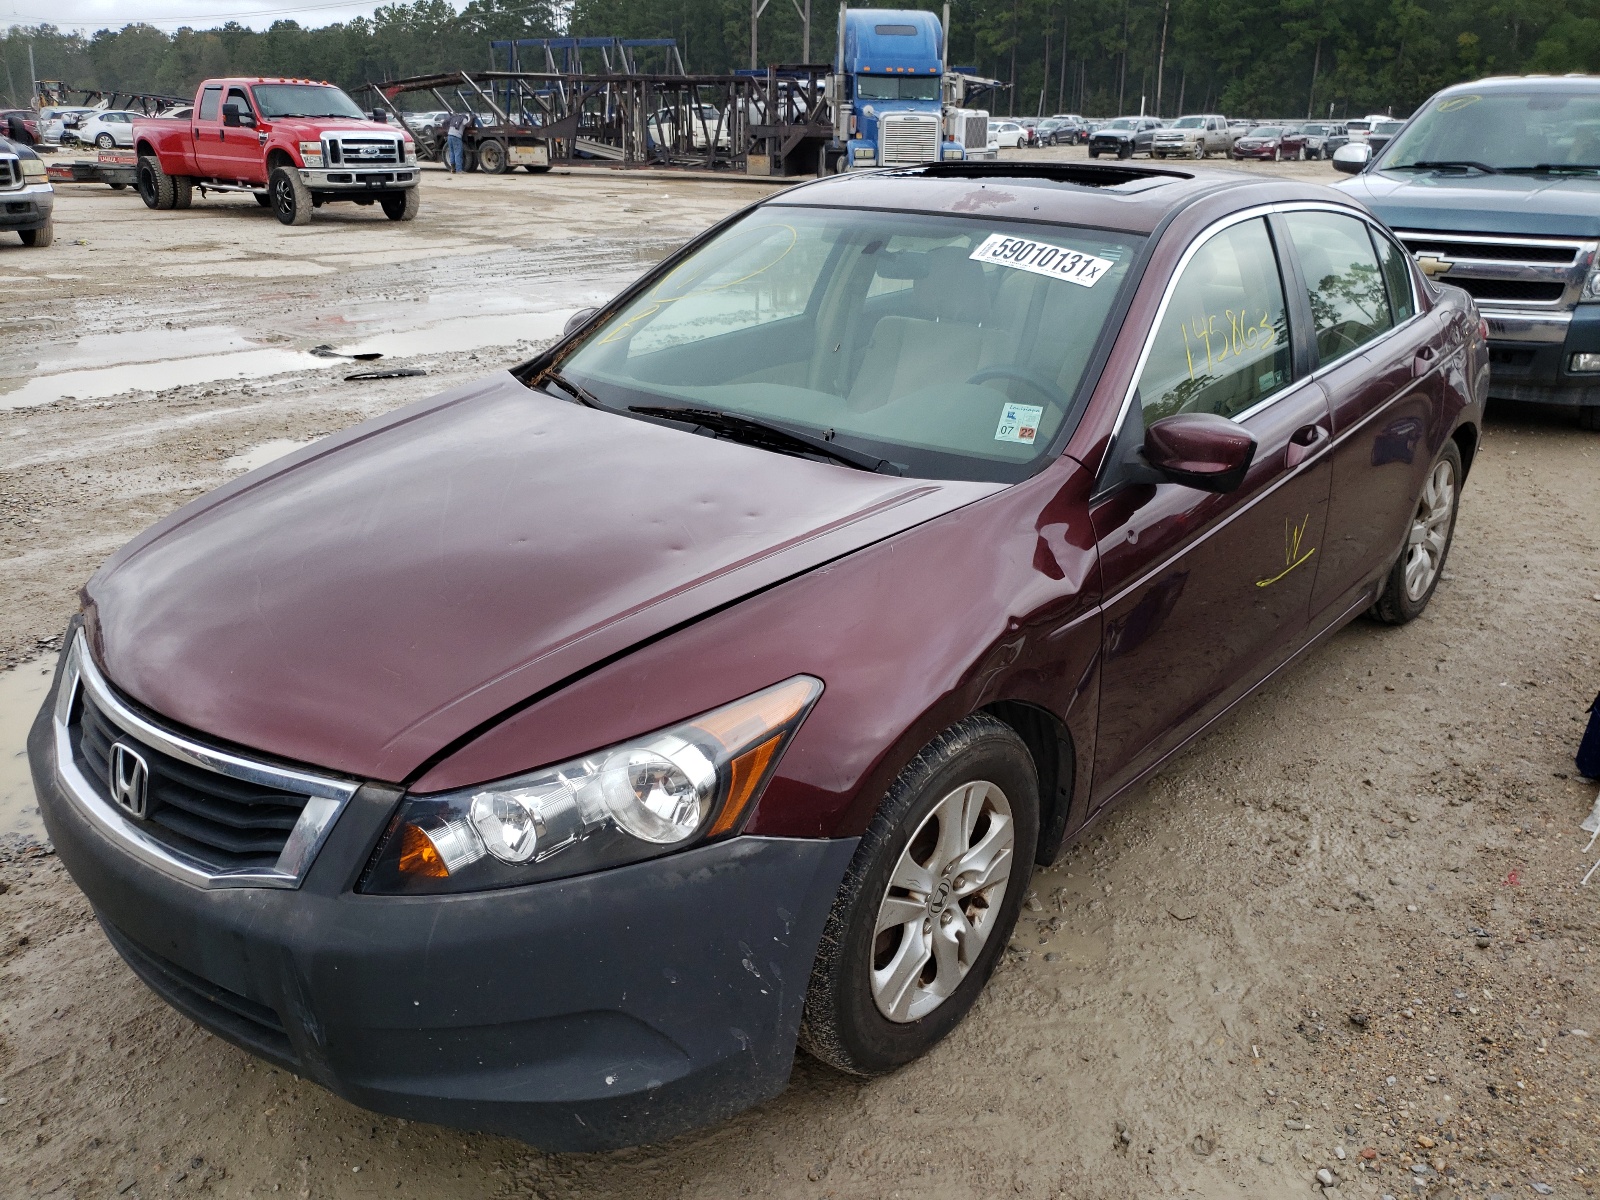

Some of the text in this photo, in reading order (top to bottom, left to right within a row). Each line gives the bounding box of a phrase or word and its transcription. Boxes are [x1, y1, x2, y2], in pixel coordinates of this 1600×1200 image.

[991, 238, 1095, 277] 59010131
[1000, 425, 1034, 438] 07 22
